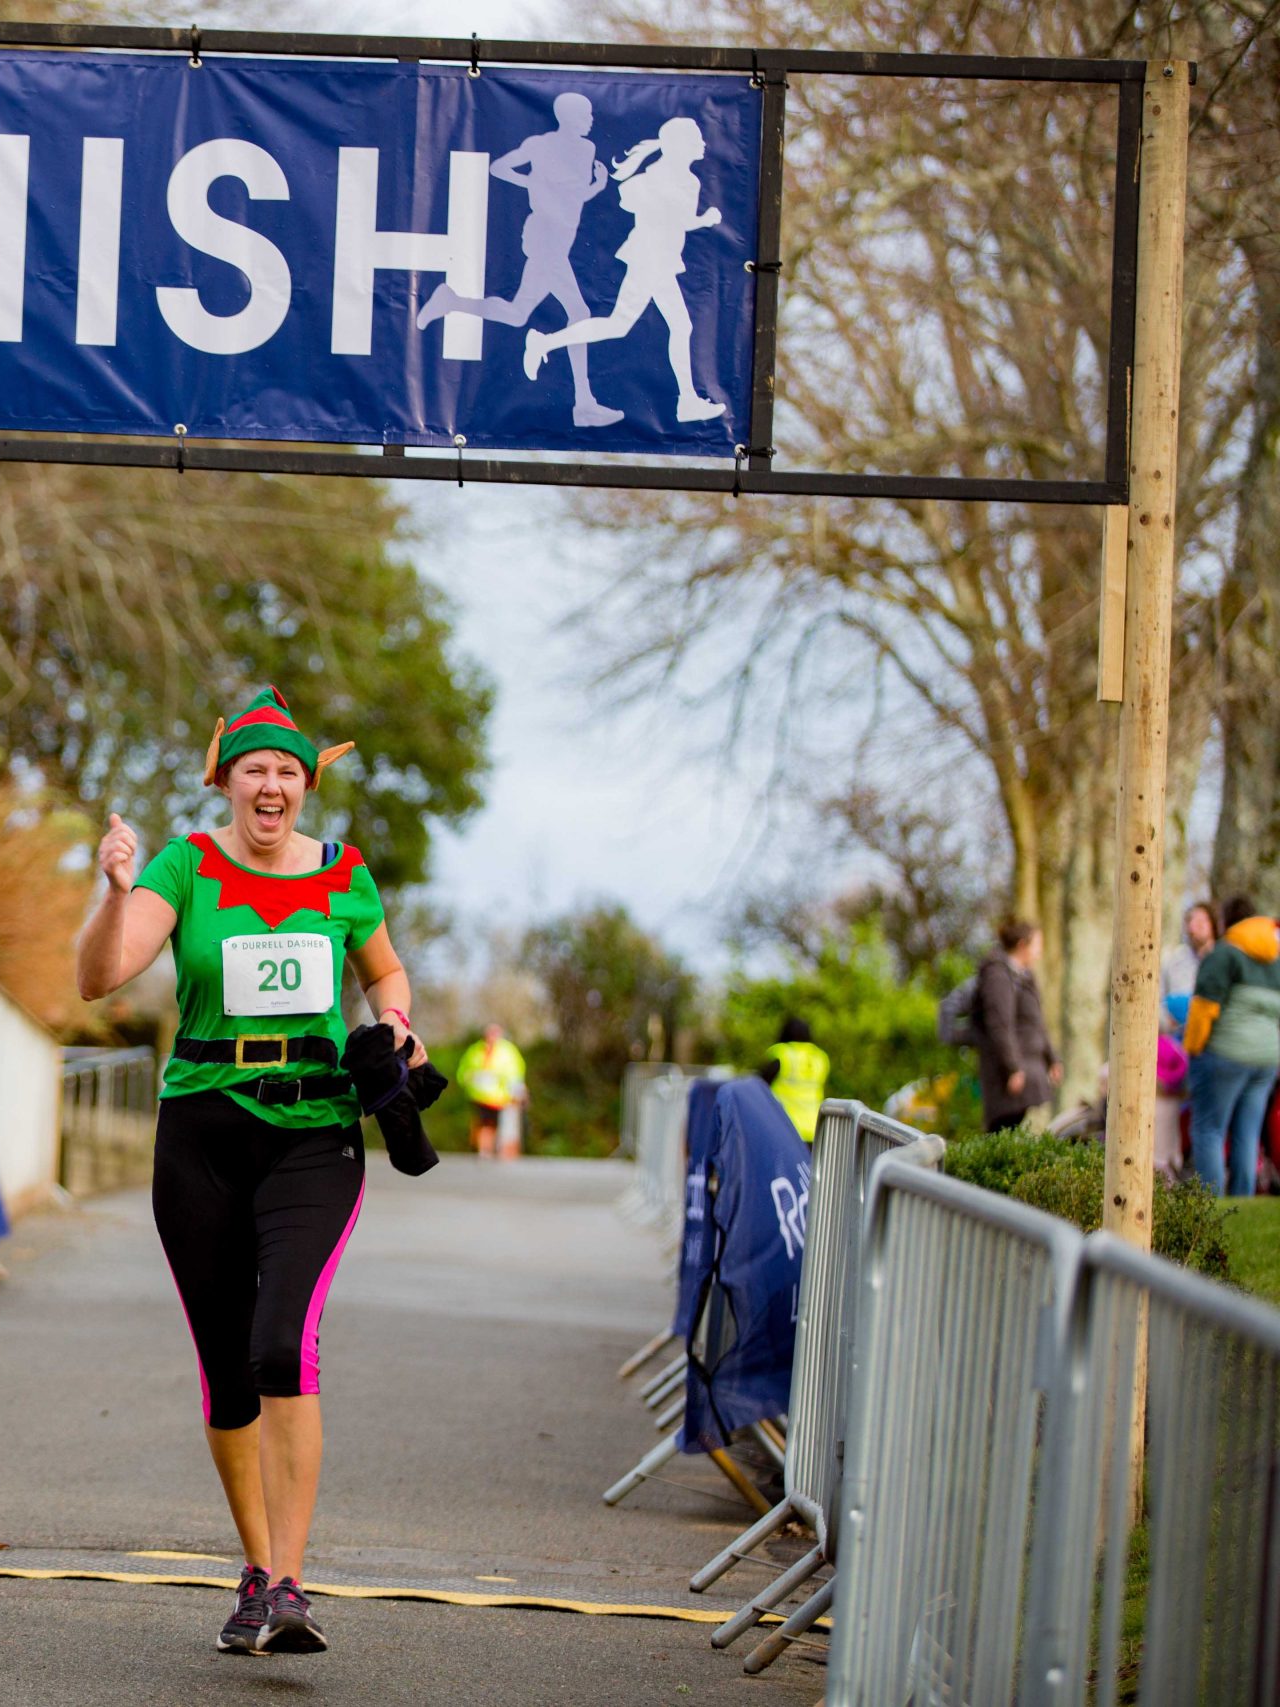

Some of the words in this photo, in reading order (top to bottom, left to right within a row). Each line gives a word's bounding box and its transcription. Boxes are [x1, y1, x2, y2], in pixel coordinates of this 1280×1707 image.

[242, 940, 284, 951] DURRELL
[287, 939, 325, 949] DASHER
[257, 958, 302, 992] 20
